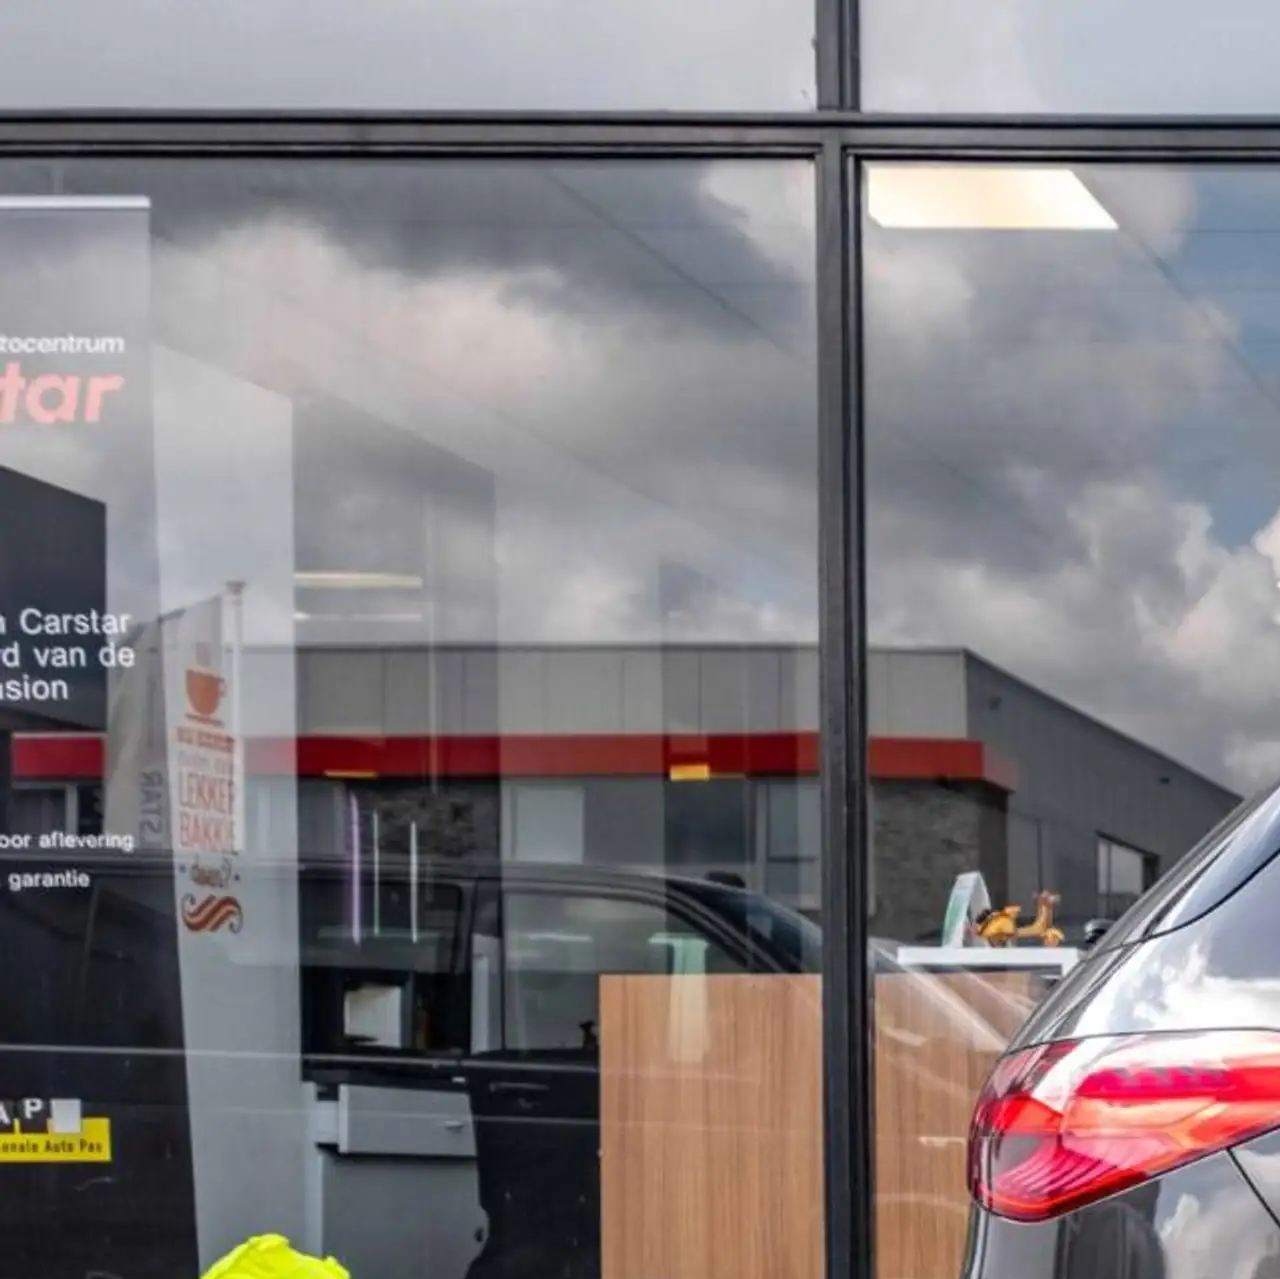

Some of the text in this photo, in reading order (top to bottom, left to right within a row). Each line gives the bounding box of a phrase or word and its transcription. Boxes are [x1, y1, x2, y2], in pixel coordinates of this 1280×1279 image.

[20, 607, 133, 636] Carstar
[32, 646, 87, 668] van
[98, 640, 135, 668] de
[39, 830, 134, 853] aflevering
[8, 868, 91, 892] garantie
